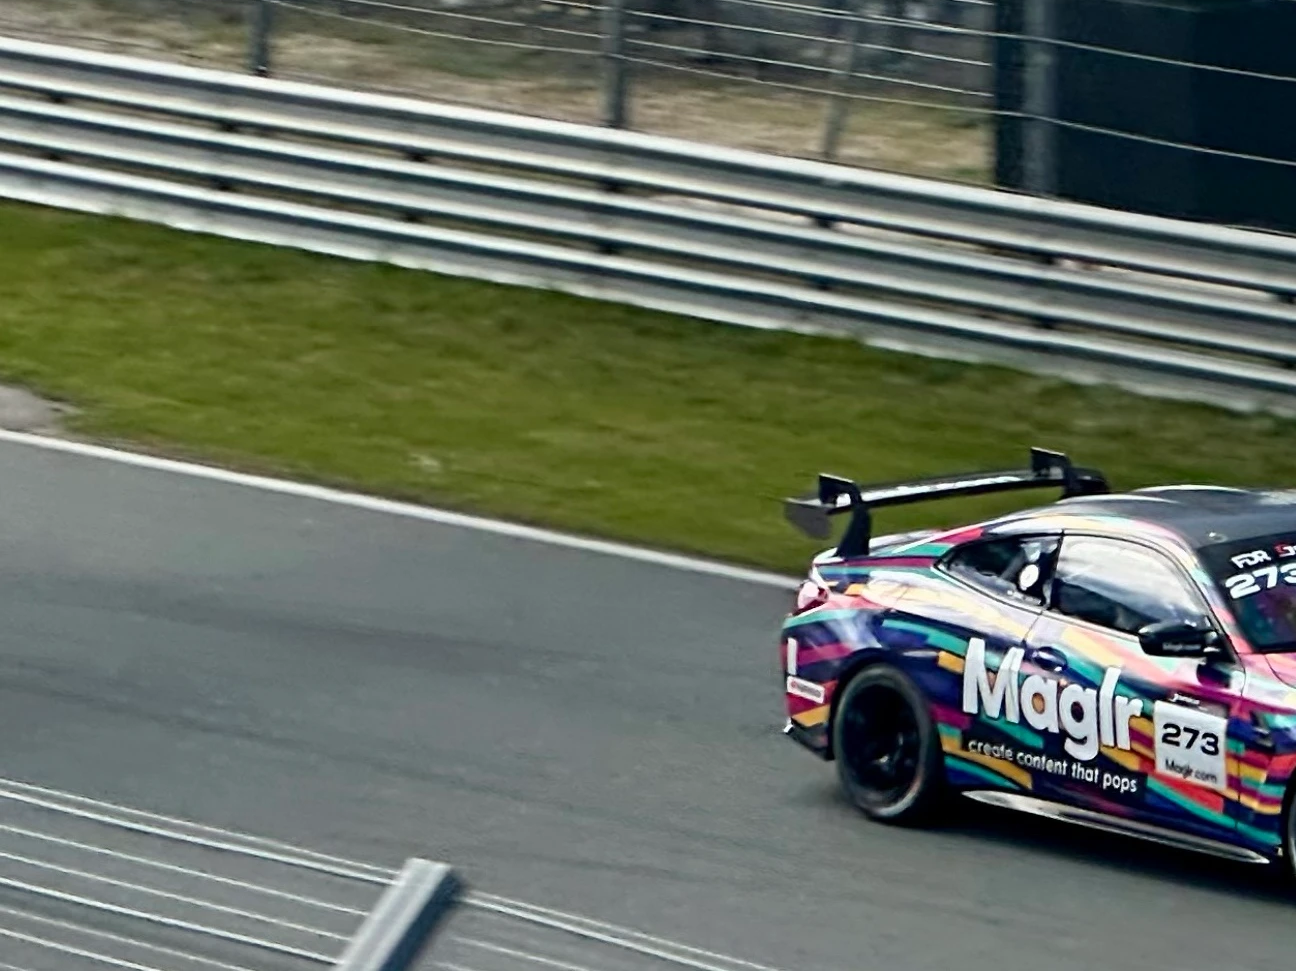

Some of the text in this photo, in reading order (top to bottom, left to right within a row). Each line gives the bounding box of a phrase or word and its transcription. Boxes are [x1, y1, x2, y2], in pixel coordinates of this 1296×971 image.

[1231, 549, 1272, 569] FDR
[961, 637, 1144, 761] Maglr
[1161, 722, 1219, 756] 273
[967, 739, 1138, 794] create content that pops
